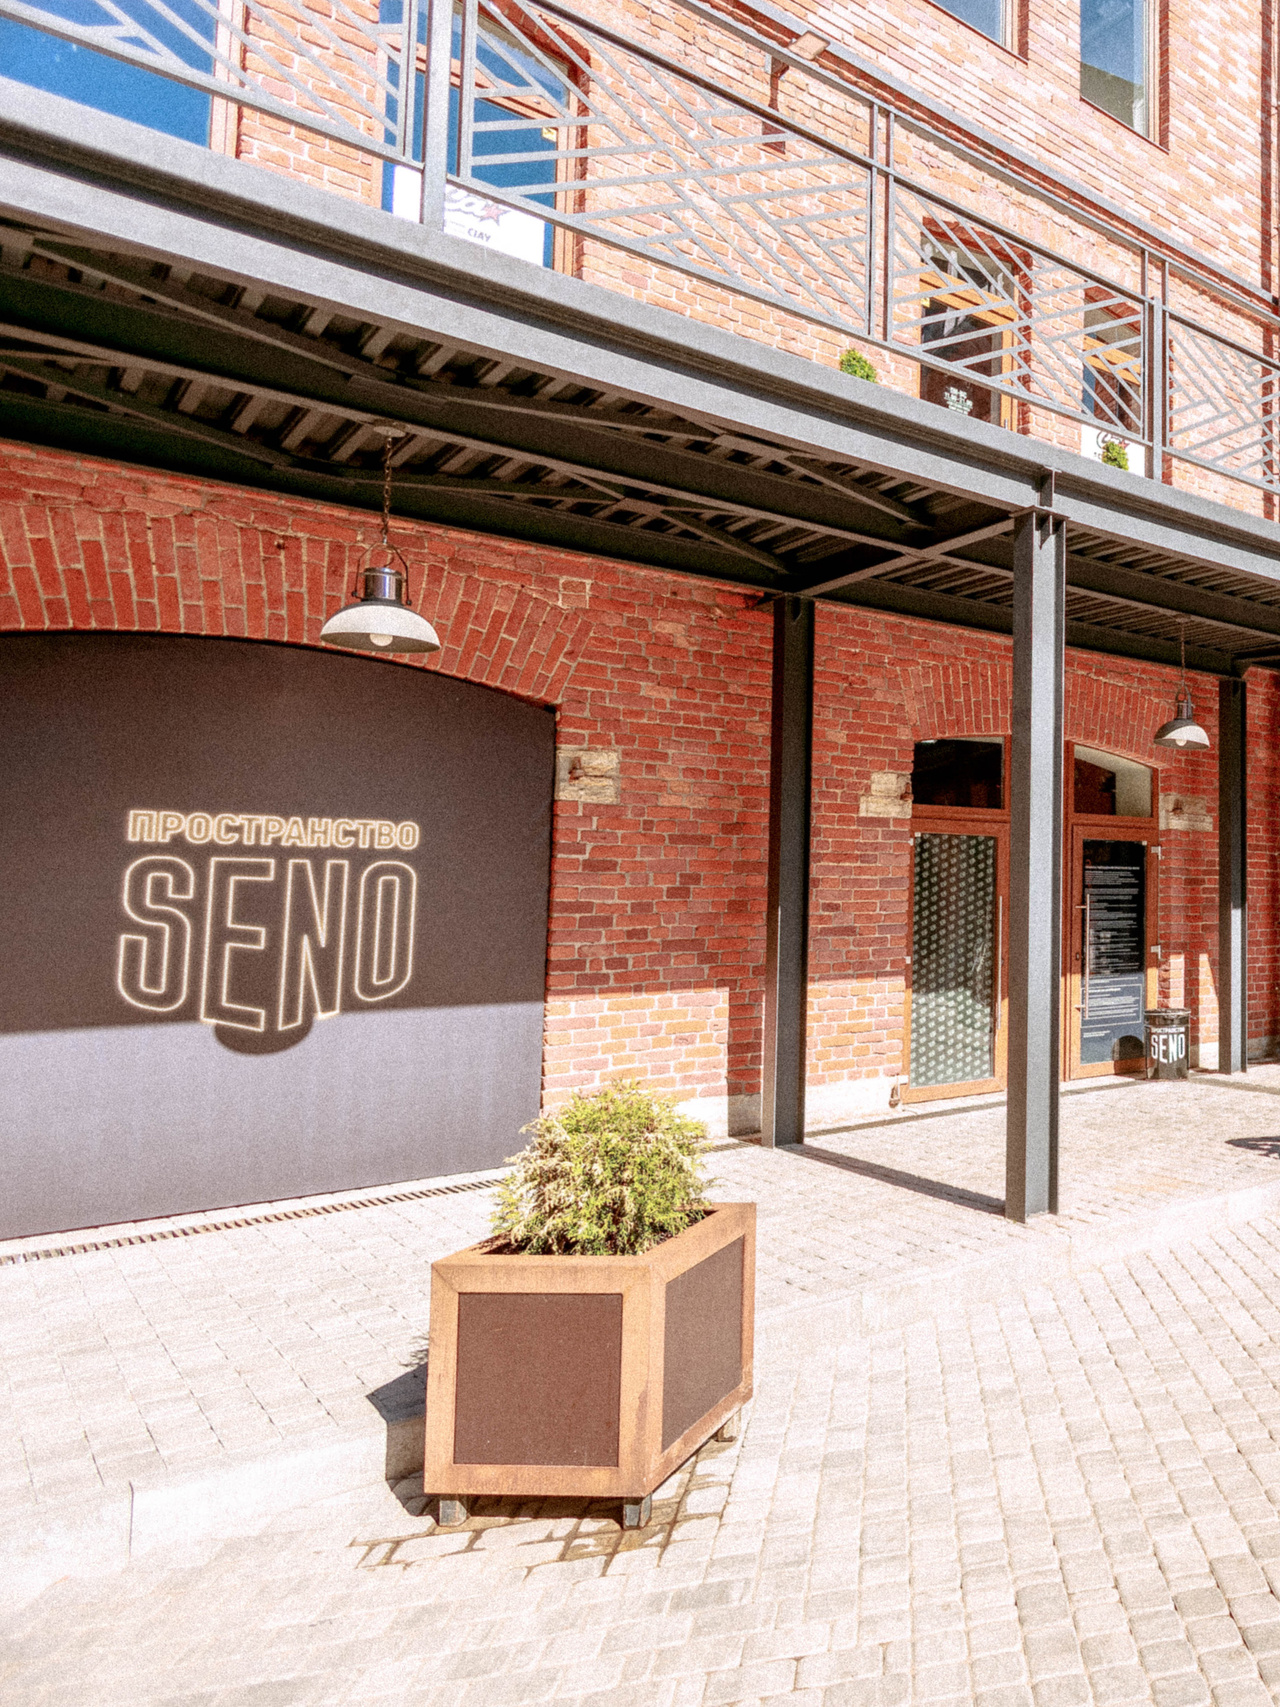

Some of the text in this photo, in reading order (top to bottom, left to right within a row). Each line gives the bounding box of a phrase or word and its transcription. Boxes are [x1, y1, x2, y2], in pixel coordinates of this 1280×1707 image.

[126, 810, 420, 850] ПРОСТРАНСТВО
[118, 855, 417, 1032] SENO
[1151, 1034, 1185, 1064] SENO
